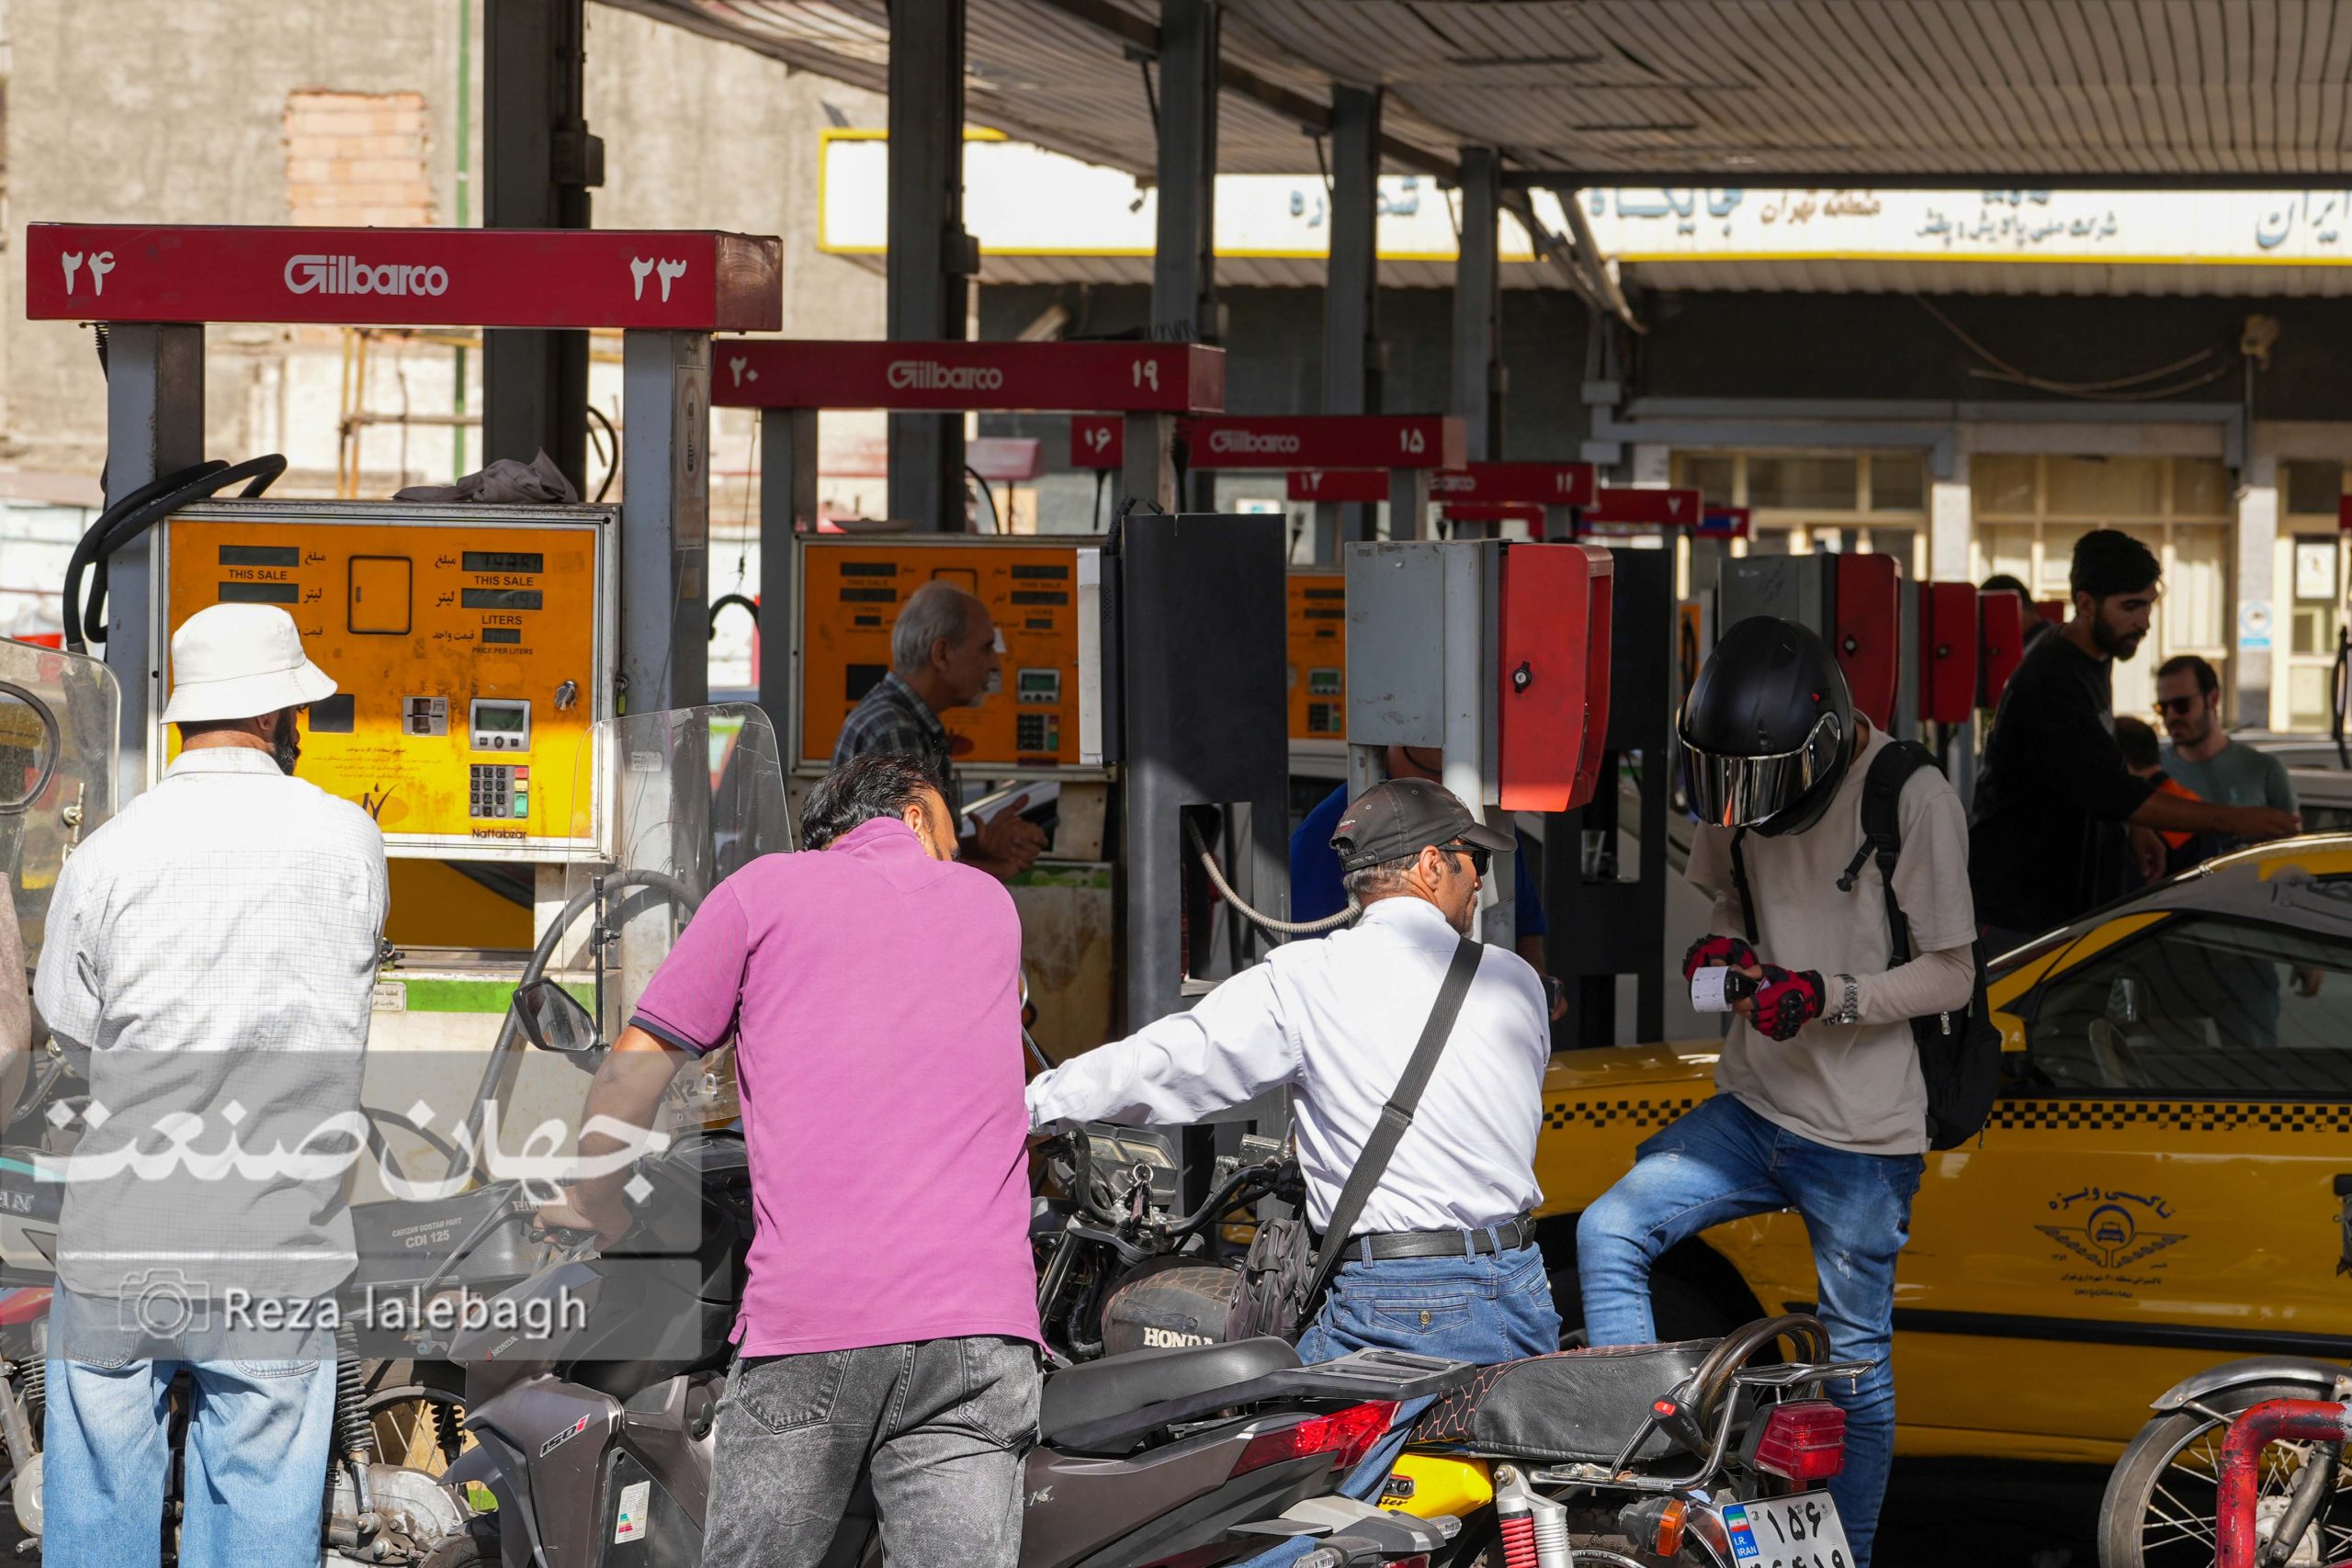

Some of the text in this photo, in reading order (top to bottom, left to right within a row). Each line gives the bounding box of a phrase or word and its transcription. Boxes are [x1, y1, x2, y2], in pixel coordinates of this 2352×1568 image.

[62, 251, 116, 297] ۲۴
[284, 254, 448, 296] Gilbarco
[629, 256, 687, 303] ۲۳
[729, 356, 758, 388] ۲۰
[887, 360, 1003, 389] Gilbarco
[1132, 359, 1159, 391] ۱۹
[1084, 427, 1112, 453] ۱۶
[1209, 429, 1300, 453] Gilbarco
[1400, 427, 1425, 453] ۱۵
[304, 551, 326, 565] مبلغ
[435, 555, 457, 569] مبلغ
[229, 570, 288, 580] THIS SALE
[474, 576, 534, 586] THIS SALE
[303, 588, 322, 604] لیتر
[435, 592, 455, 607] لیتر
[481, 615, 522, 626] LITERS
[454, 630, 475, 642] قیمت
[471, 829, 526, 839] Naftabzar
[2104, 1190, 2176, 1219] تاکسی
[419, 1221, 445, 1233] GOSTAR
[445, 1217, 462, 1227] PART
[405, 1229, 450, 1249] CDI 125
[492, 1336, 518, 1358] HONDA
[1767, 1501, 1822, 1544] ۱۵۶
[1736, 1546, 1758, 1557] IRAN
